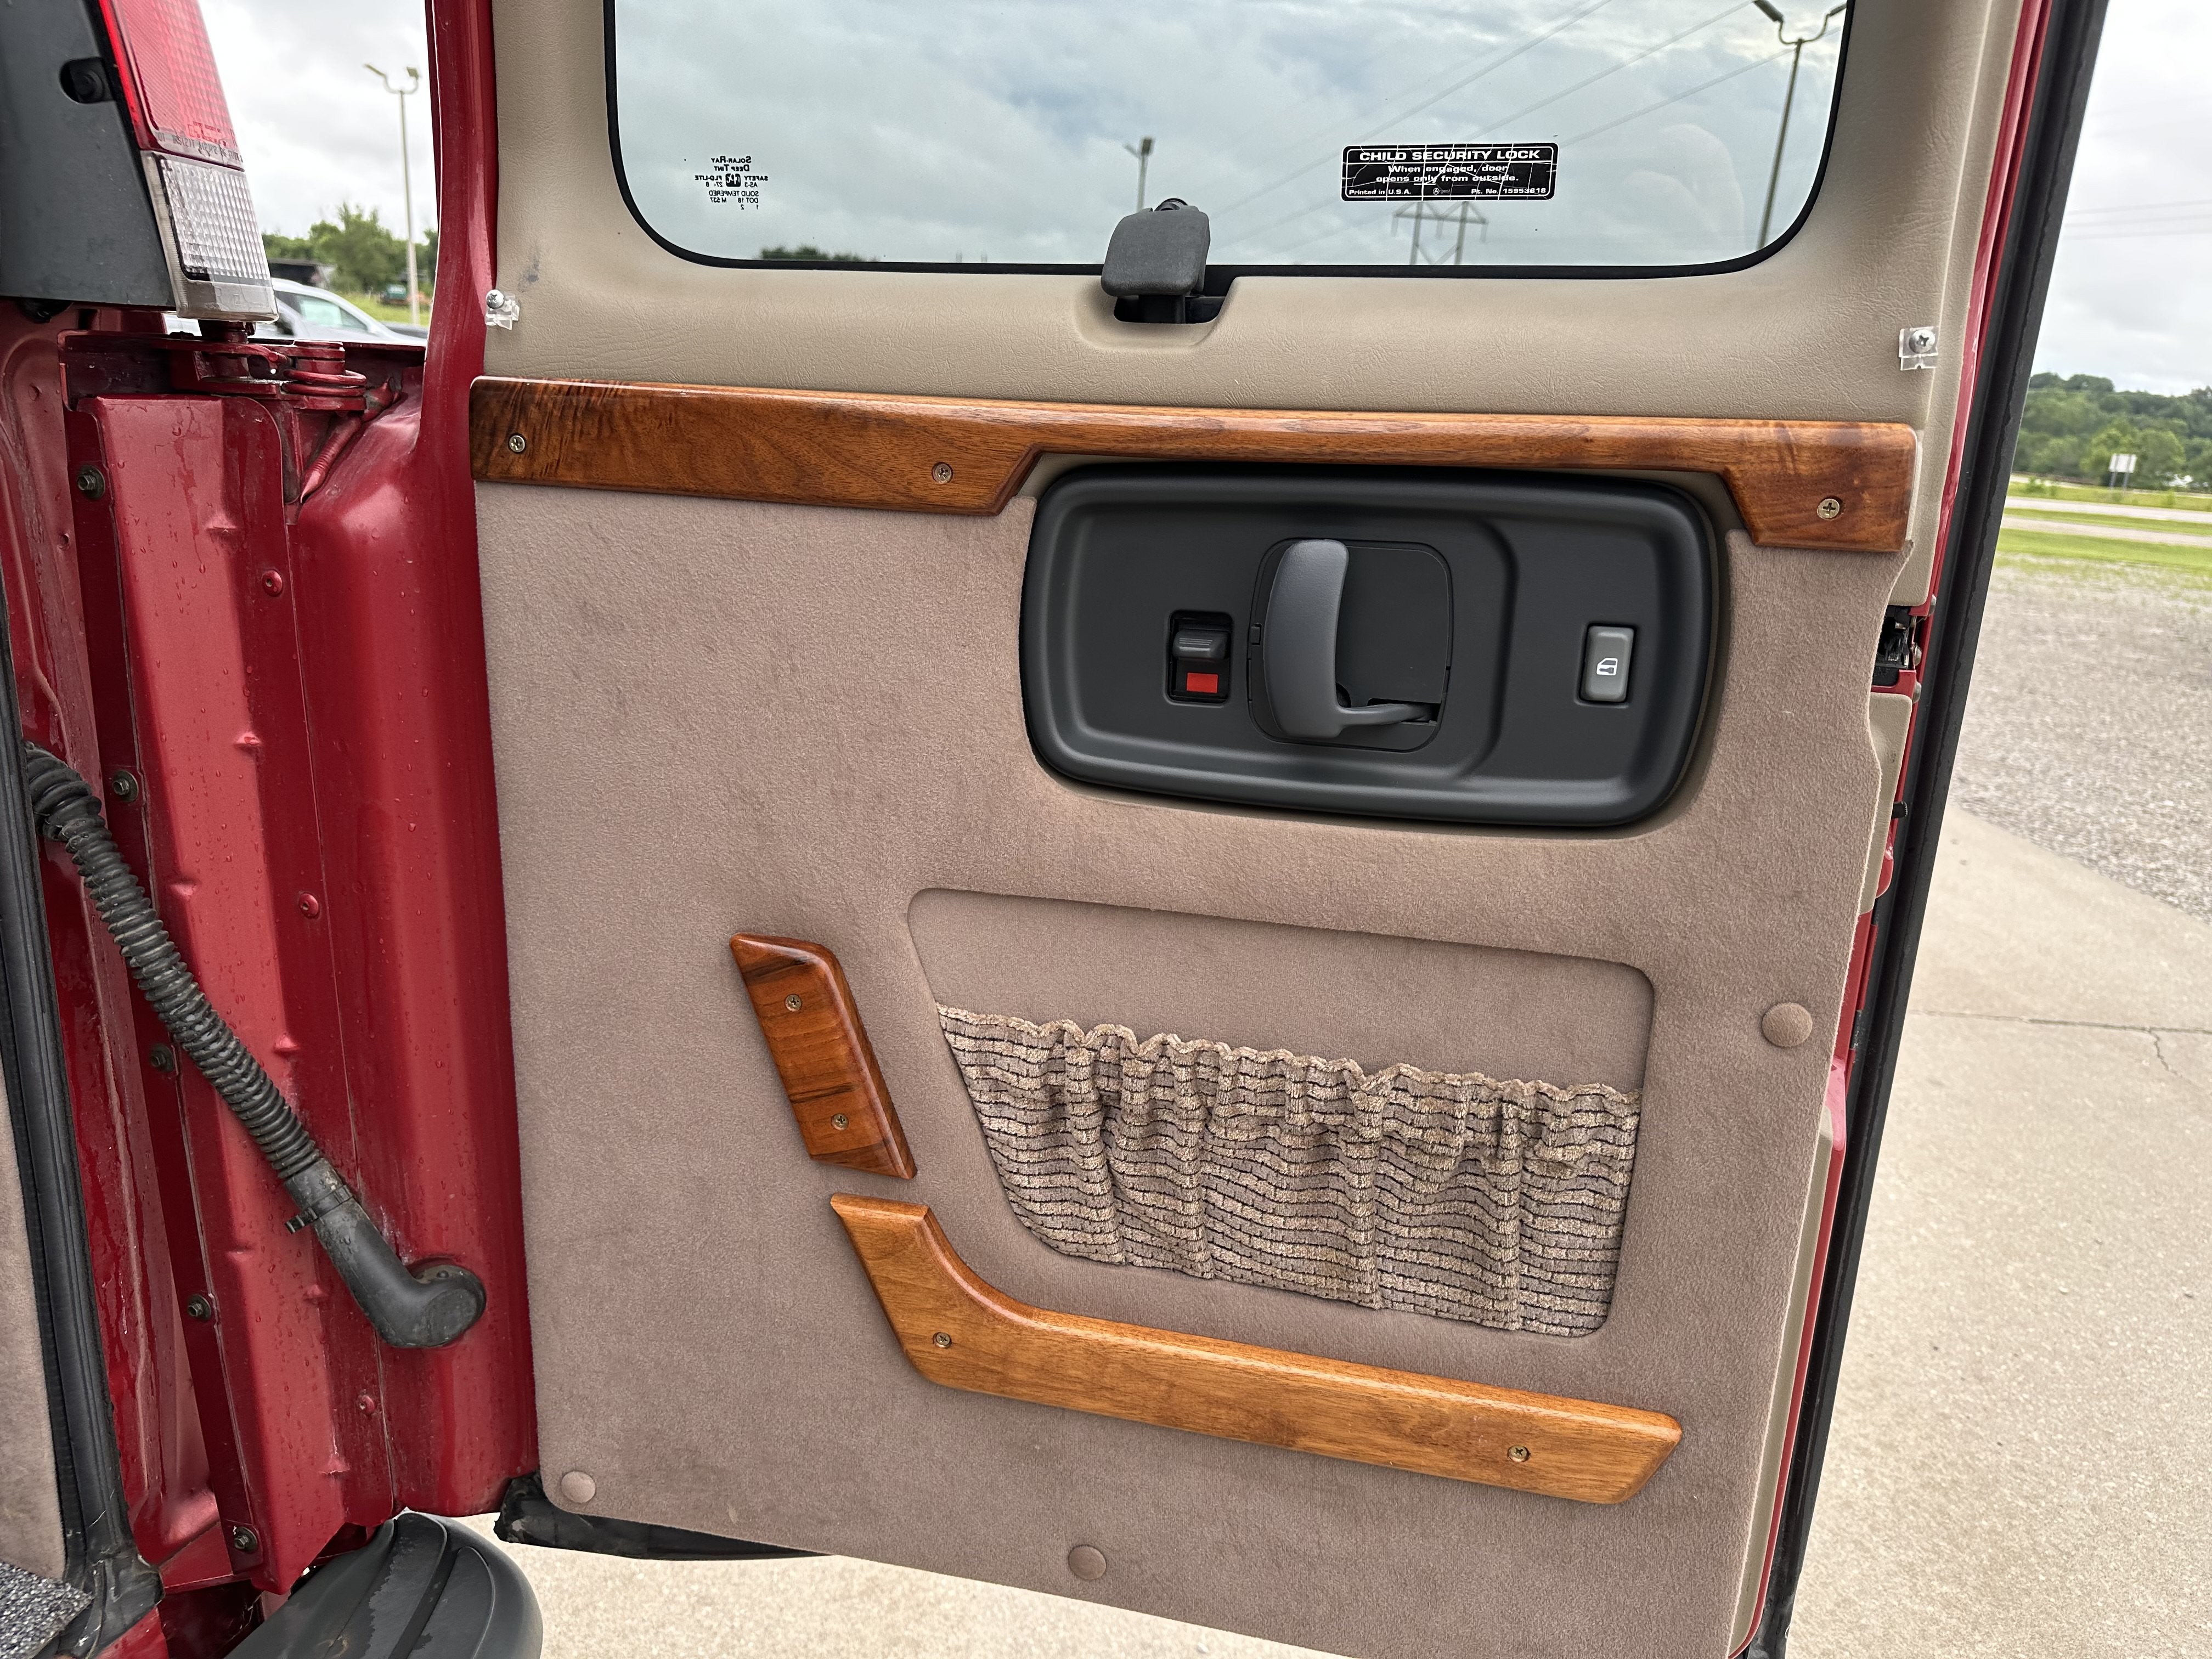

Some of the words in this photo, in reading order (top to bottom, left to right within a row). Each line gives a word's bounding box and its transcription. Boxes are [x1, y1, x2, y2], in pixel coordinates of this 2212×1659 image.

[1359, 151, 1407, 161] CHILD
[1412, 150, 1492, 160] SECURITY
[1497, 150, 1541, 160] LOCK
[1425, 165, 1476, 174] engaged,
[1413, 174, 1438, 184] only
